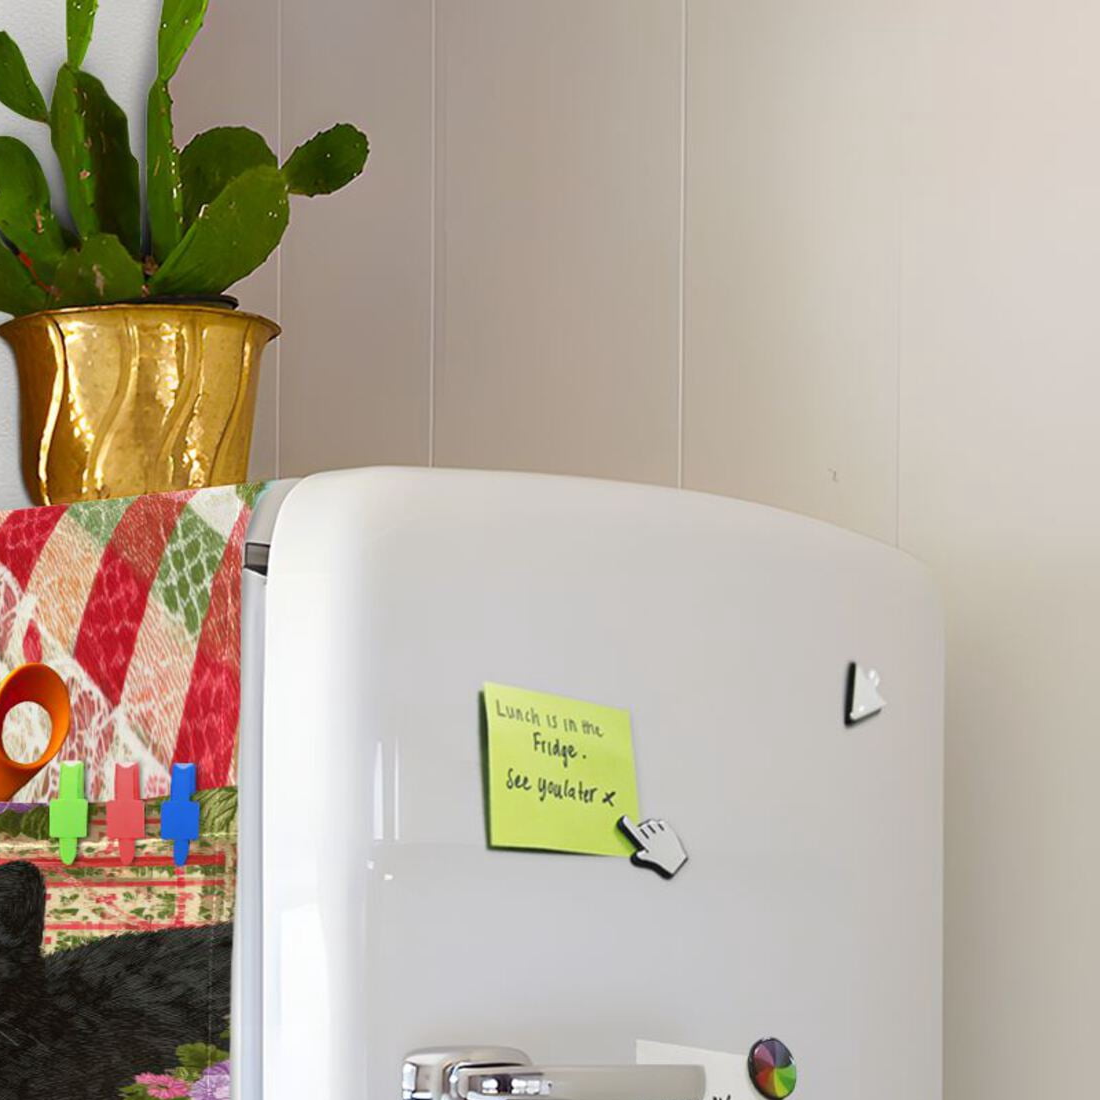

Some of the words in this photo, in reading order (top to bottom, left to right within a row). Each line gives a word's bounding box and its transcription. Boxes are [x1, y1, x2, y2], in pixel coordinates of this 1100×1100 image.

[496, 700, 540, 726] Lunch
[546, 715, 558, 728] is
[564, 719, 577, 733] in
[582, 720, 603, 737] the
[506, 768, 531, 790] See
